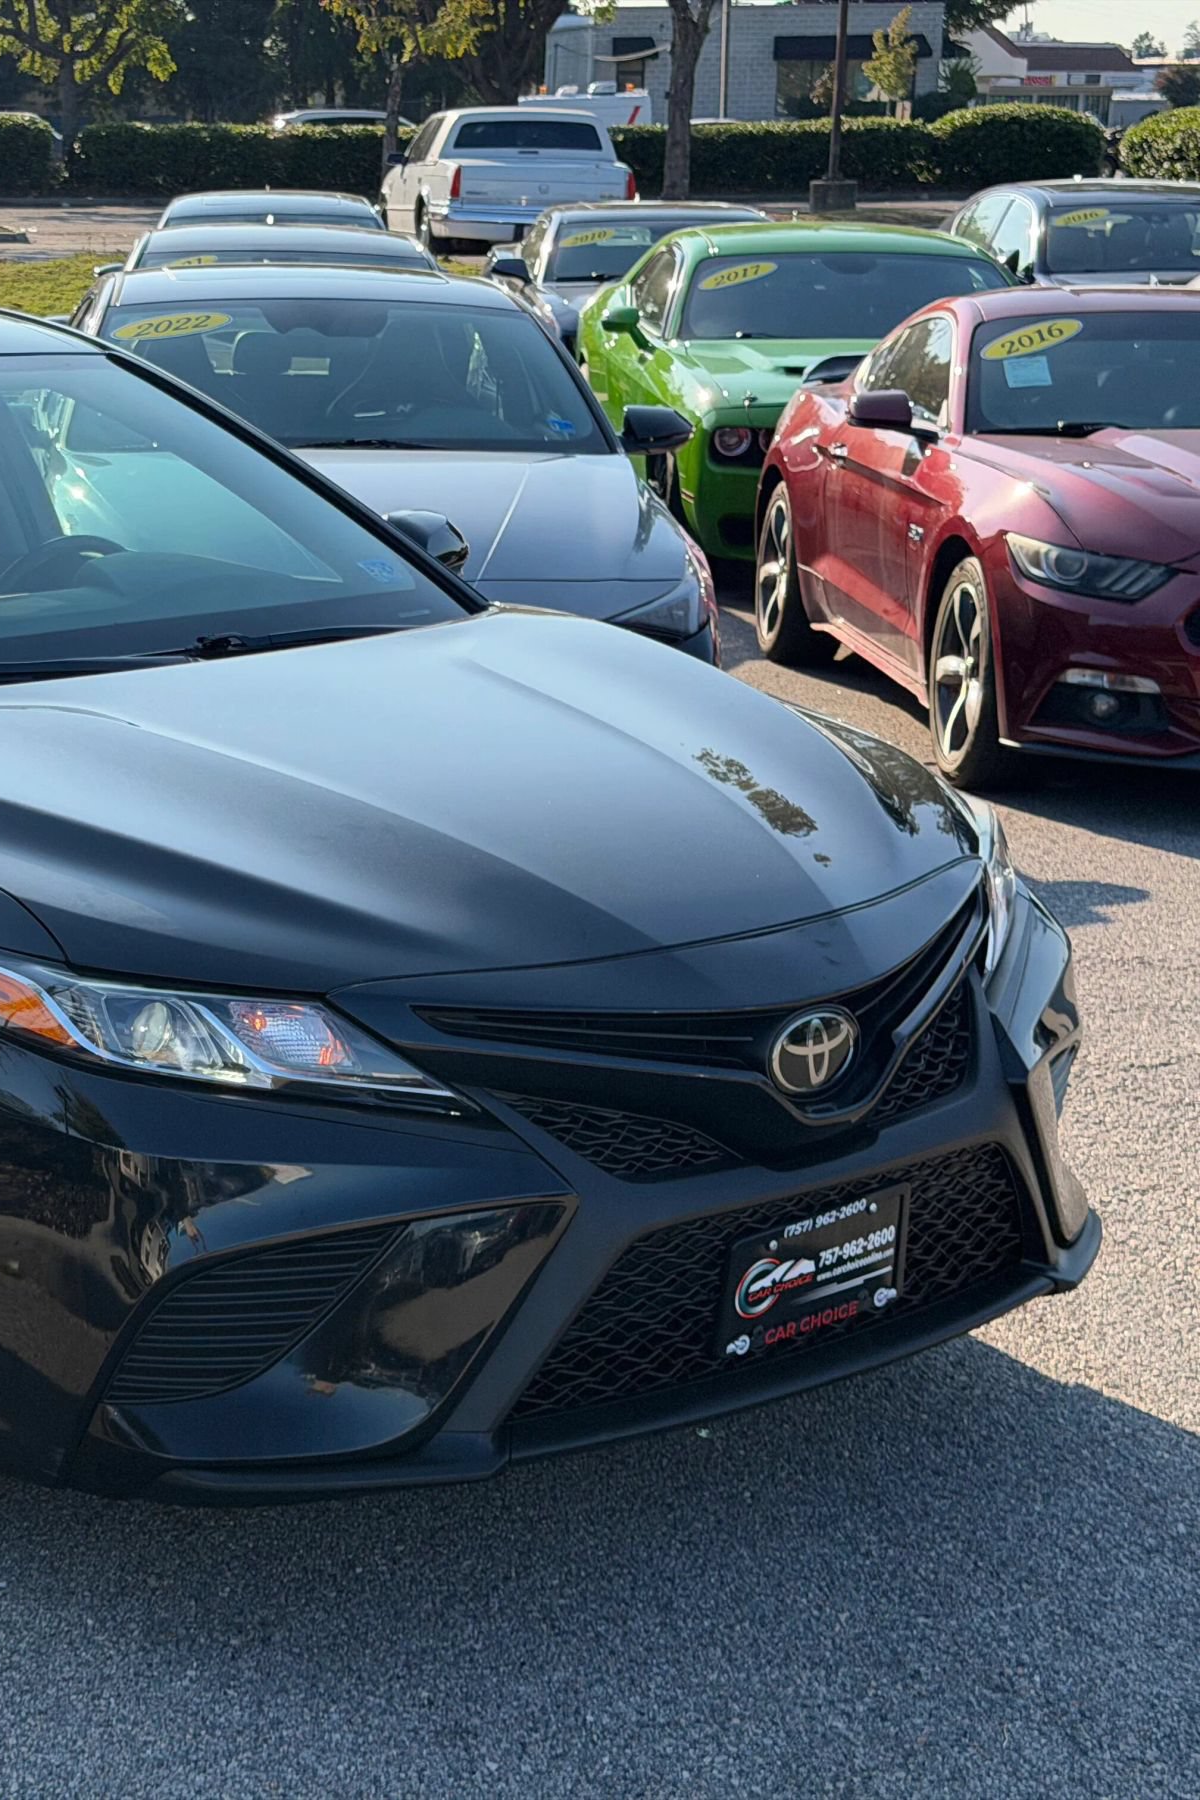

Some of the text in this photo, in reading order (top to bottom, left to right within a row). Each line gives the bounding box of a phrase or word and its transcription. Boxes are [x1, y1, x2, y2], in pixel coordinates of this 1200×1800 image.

[714, 265, 761, 286] 2017
[131, 314, 213, 338] 2022
[1001, 323, 1064, 355] 2016
[784, 1198, 867, 1239] (757) 962-2600
[818, 1224, 896, 1268] 757-962-2600
[748, 1273, 815, 1302] CAR CHOICE
[765, 1300, 860, 1345] CAR CHOICE
